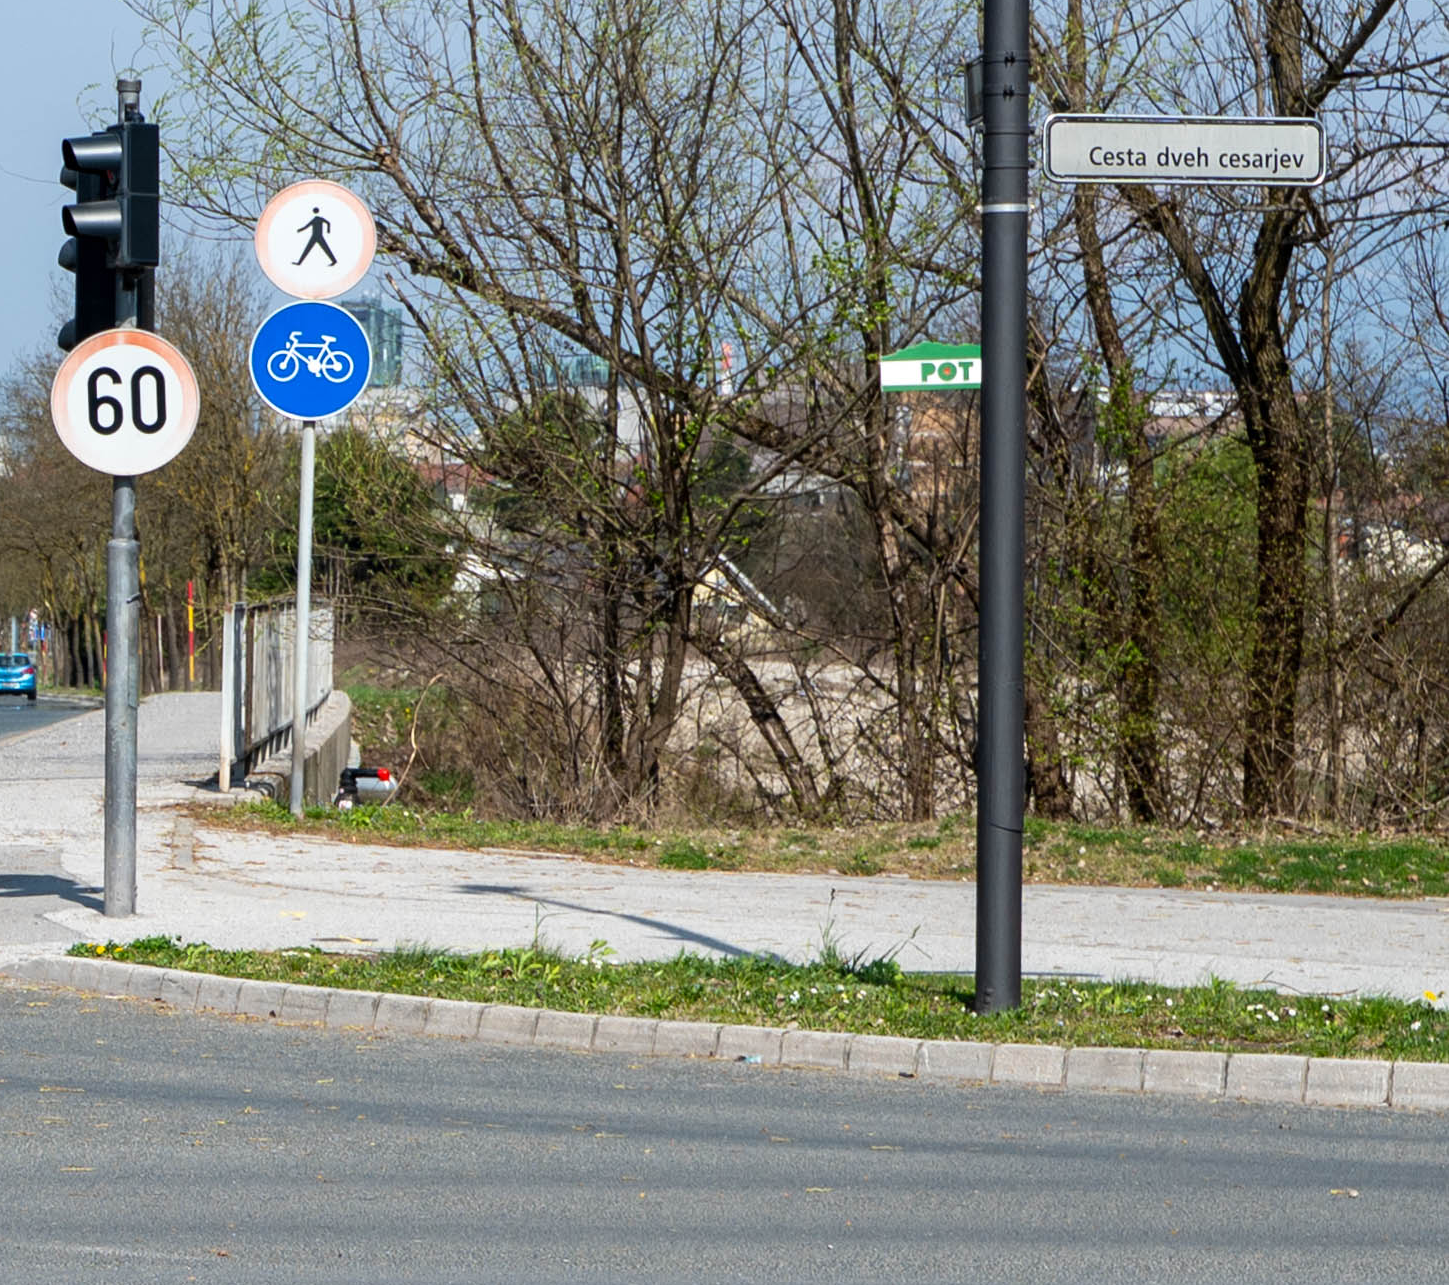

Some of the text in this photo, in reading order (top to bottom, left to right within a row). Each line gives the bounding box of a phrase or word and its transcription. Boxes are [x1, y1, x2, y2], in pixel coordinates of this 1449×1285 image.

[1089, 146, 1305, 174] Cesta dveh cesarjev
[921, 361, 974, 383] POT
[87, 365, 167, 435] 60
